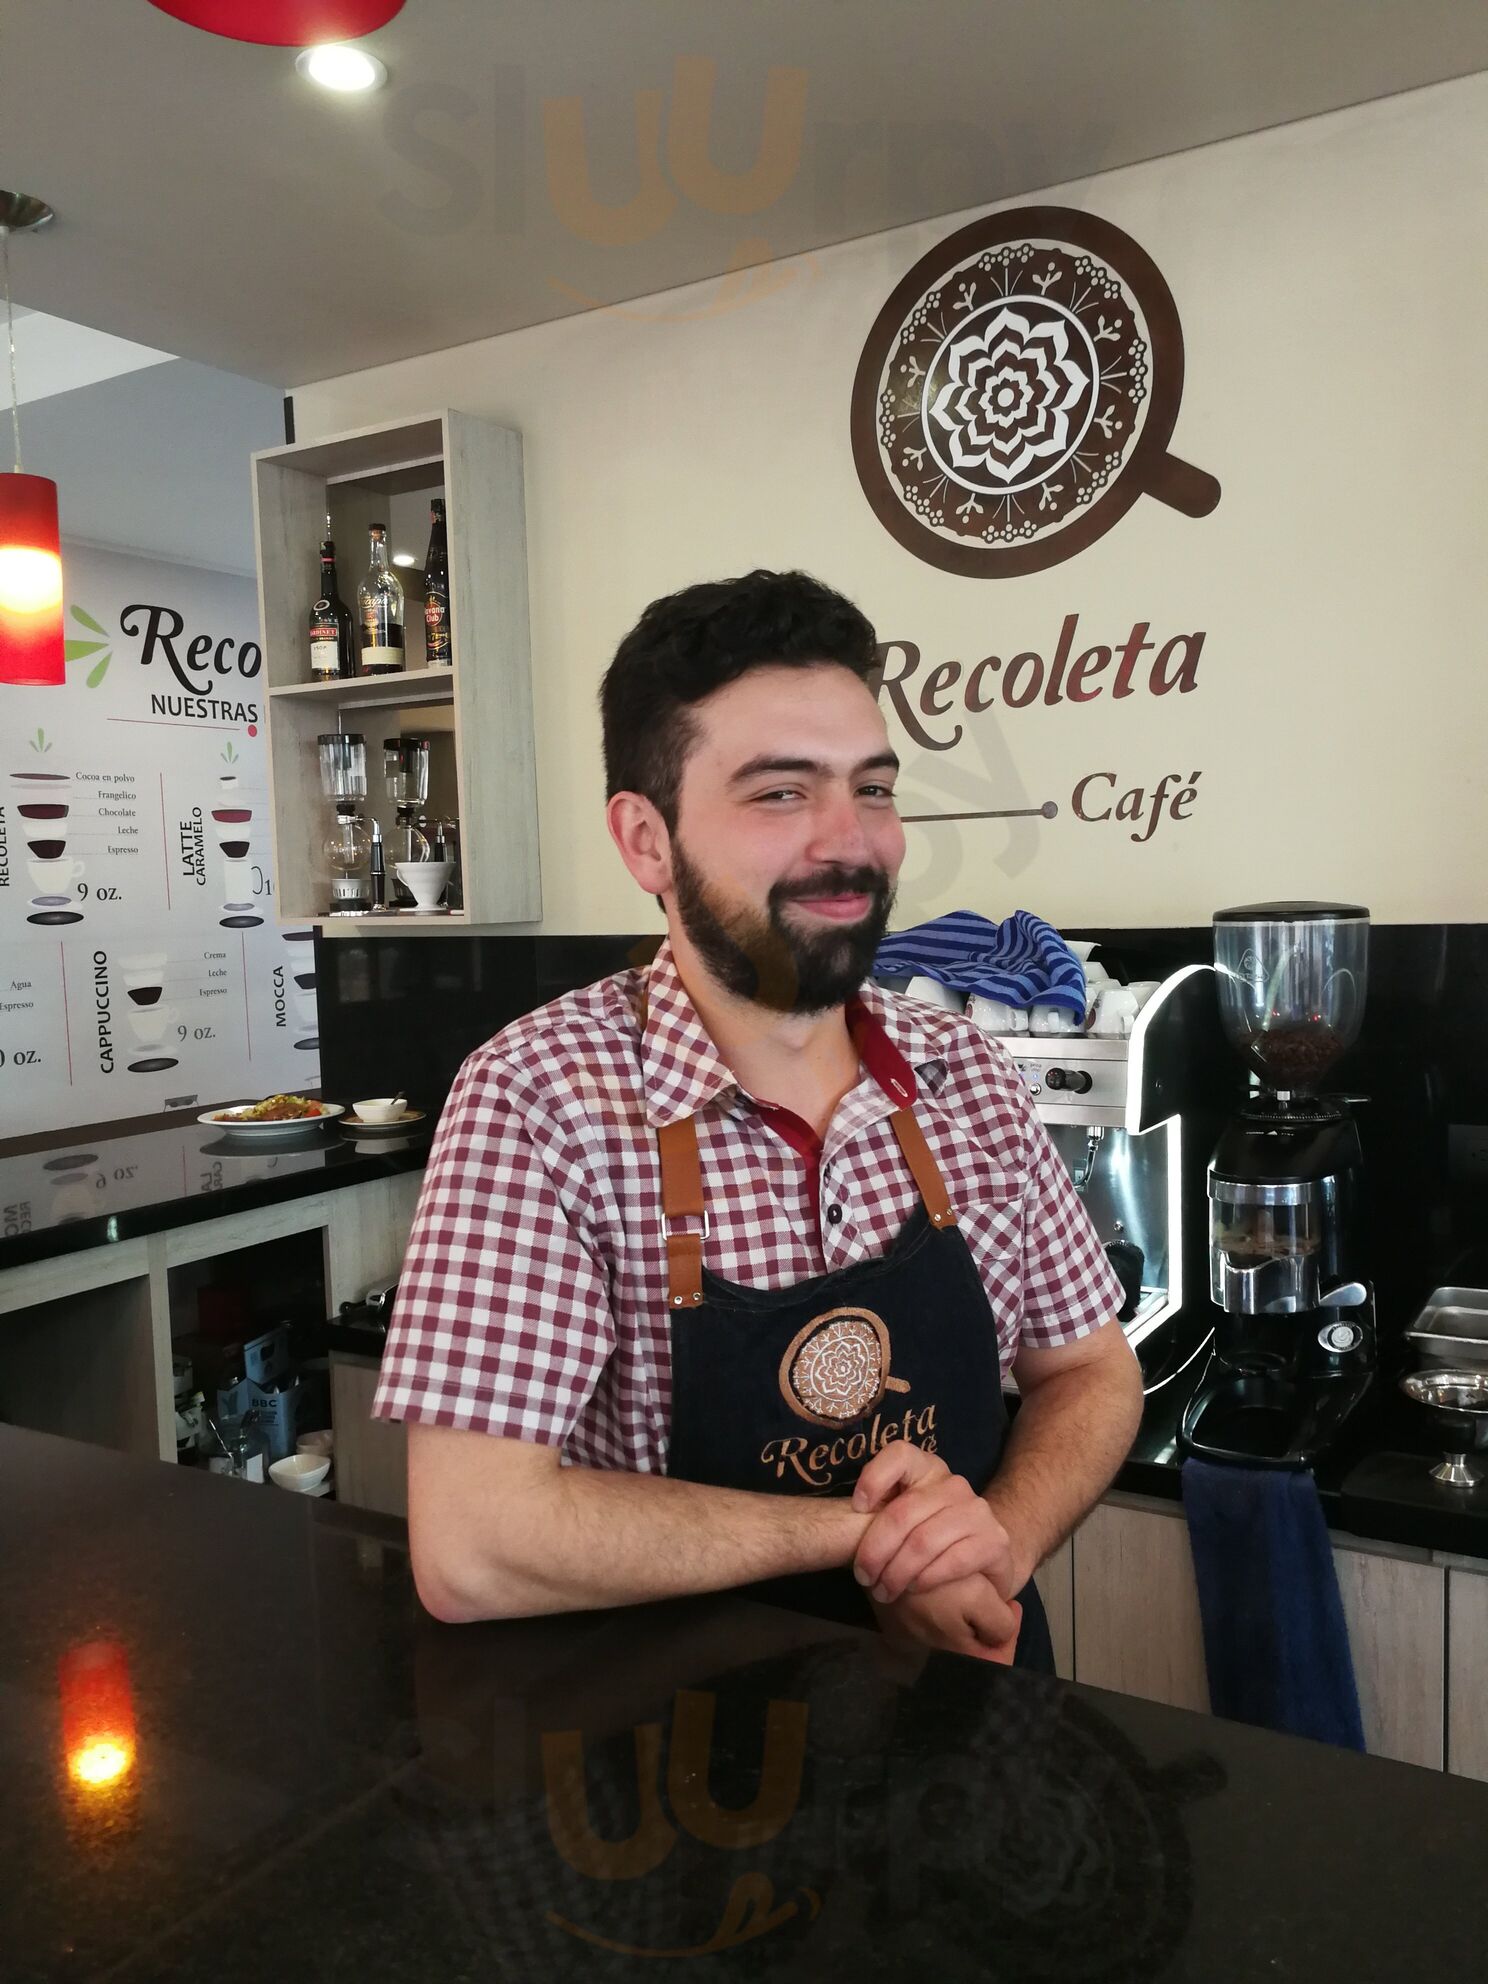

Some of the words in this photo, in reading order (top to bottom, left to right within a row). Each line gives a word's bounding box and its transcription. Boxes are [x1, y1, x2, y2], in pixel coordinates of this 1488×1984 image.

[425, 606, 445, 615] avana
[867, 613, 1206, 751] Recoleta
[151, 694, 259, 723] NUESTRAS
[75, 771, 100, 781] Cocoa
[114, 773, 135, 784] polvo
[98, 790, 137, 801] Frangelico
[98, 807, 136, 817] Chocolate
[1071, 771, 1203, 842] Café
[117, 826, 139, 834] Leche
[107, 845, 139, 856] Espresso
[180, 821, 195, 876] LATTE
[192, 806, 207, 886] CARAMELO
[77, 883, 89, 902] 9
[96, 886, 122, 901] oz.
[203, 951, 227, 960] Crema
[208, 968, 228, 977] Leche
[10, 980, 32, 991] Agua
[199, 987, 228, 997] Espresso
[272, 965, 287, 1028] MOCCA
[93, 950, 114, 1074] CAPPUCCINO
[177, 1025, 188, 1042] 9
[194, 1026, 216, 1041] oz.
[13, 1050, 42, 1066] oz.
[760, 1404, 937, 1486] Recoleta
